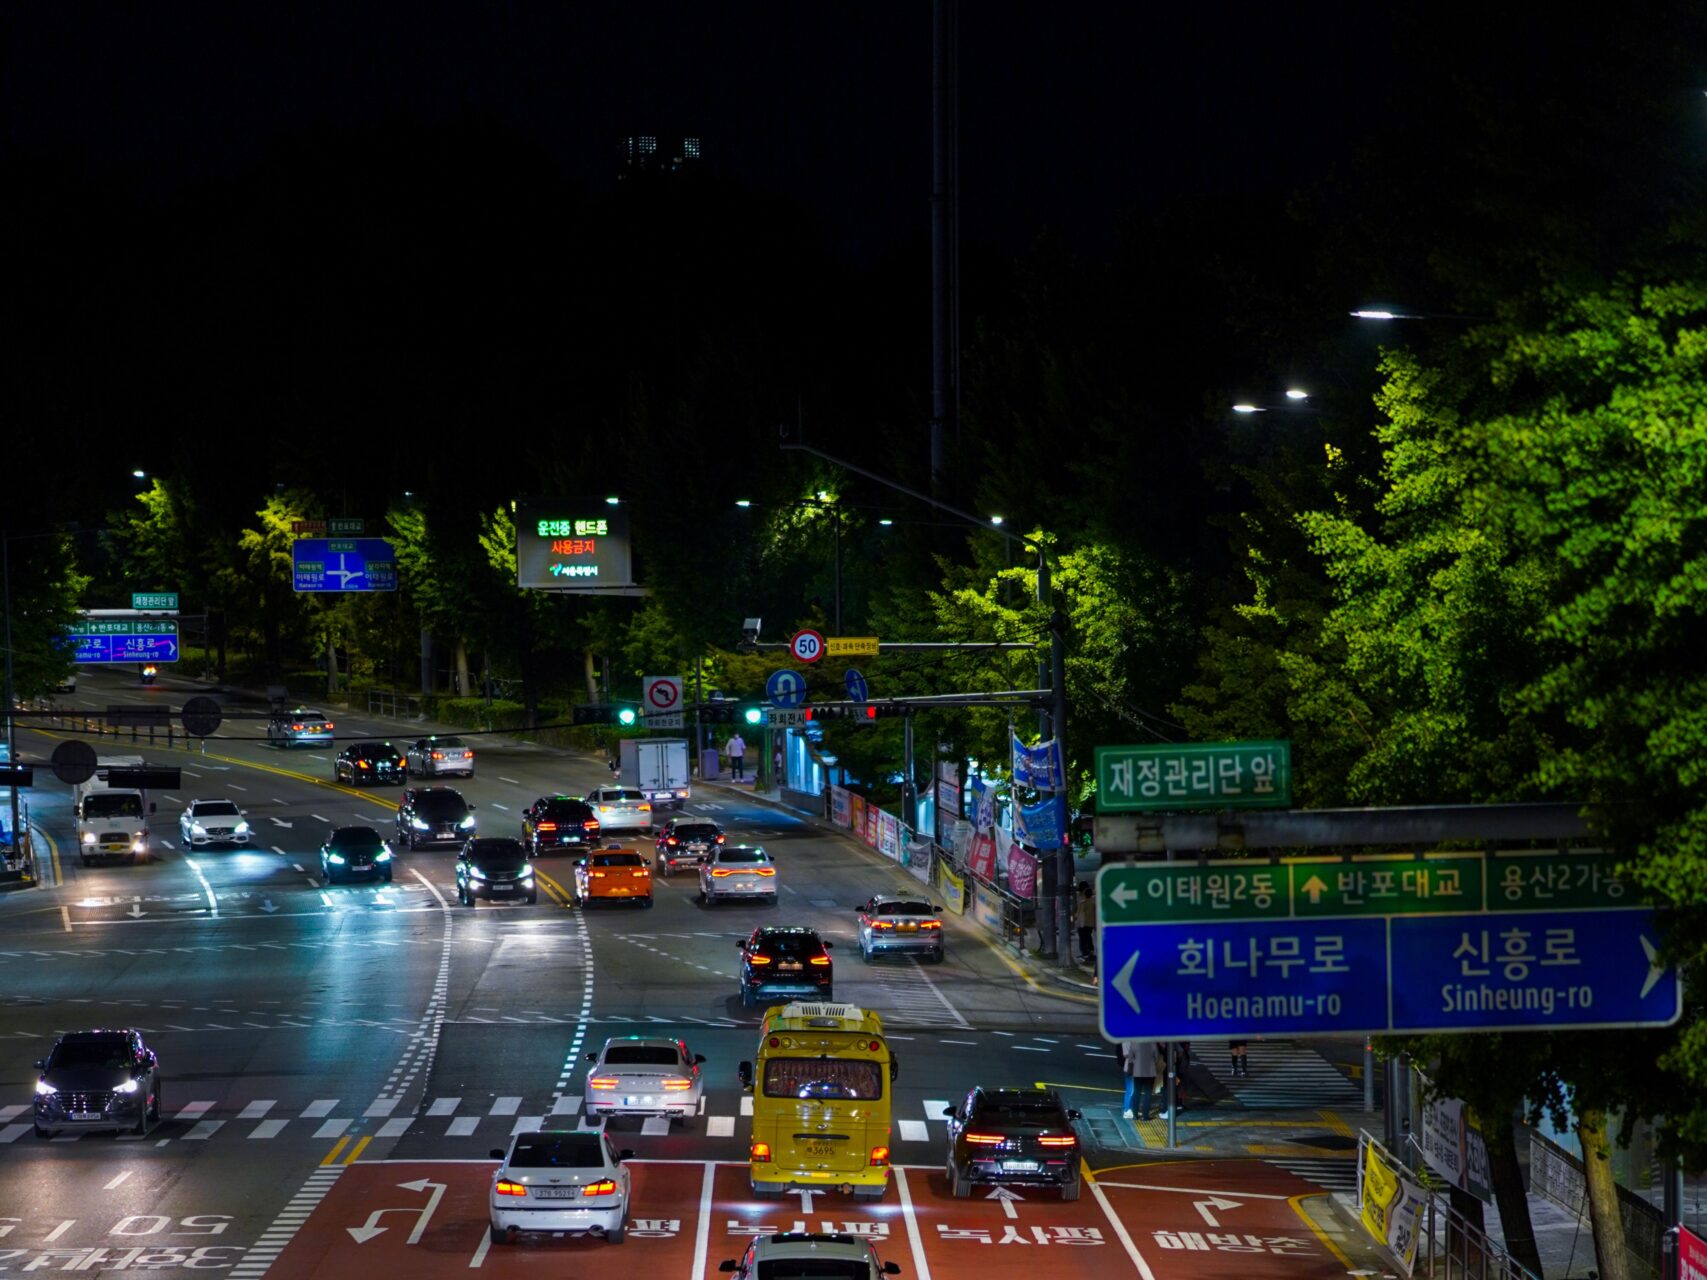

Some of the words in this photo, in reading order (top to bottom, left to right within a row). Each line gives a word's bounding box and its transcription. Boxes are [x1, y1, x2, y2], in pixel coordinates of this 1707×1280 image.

[538, 520, 570, 537] 운전중
[575, 519, 608, 536] 핸드폰
[552, 539, 594, 555] 사용금지
[126, 638, 156, 651] 신흥로
[800, 638, 816, 654] 50
[1110, 755, 1243, 798] 재정관리단
[1250, 753, 1276, 794] 앞
[1147, 873, 1277, 910] 이태원2동
[1337, 868, 1464, 906] 반포대교
[1176, 936, 1350, 979] 회나무로
[1452, 927, 1582, 982] 신흥로
[1187, 992, 1342, 1020] Hoenamu-ro
[1441, 984, 1593, 1015] Sinheung-ro
[106, 1215, 235, 1237] 50
[936, 1223, 1107, 1246] 녹사평
[1151, 1229, 1322, 1257] 해방촌
